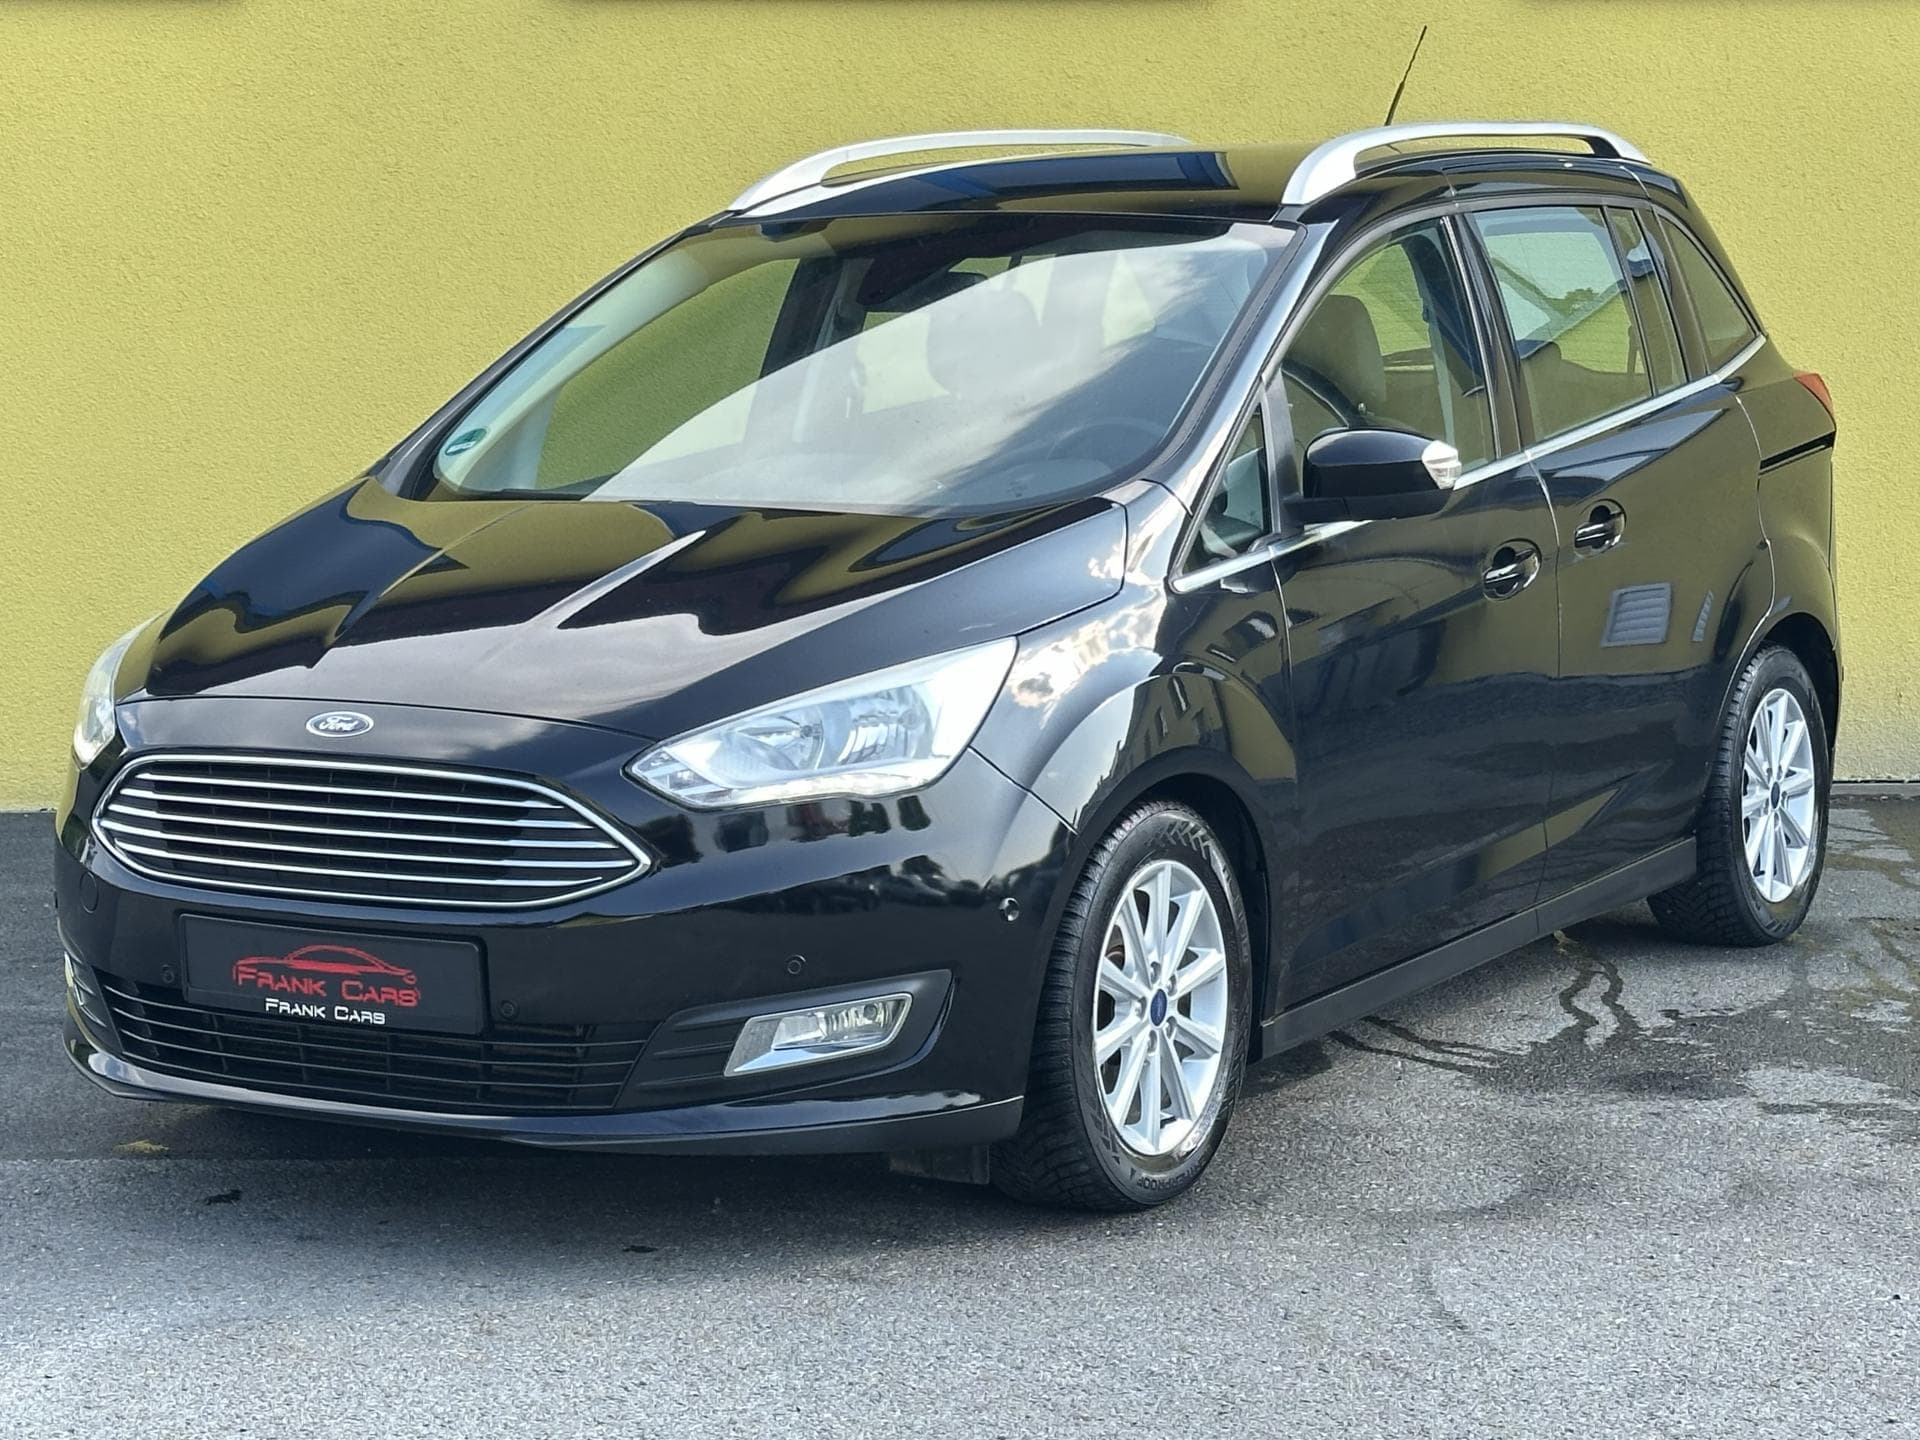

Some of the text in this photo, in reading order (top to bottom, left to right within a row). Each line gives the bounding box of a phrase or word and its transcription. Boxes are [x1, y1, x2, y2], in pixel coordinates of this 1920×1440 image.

[319, 715, 359, 731] Ford
[238, 966, 418, 1007] FRANK CARS
[265, 998, 386, 1025] FRANK CARS
